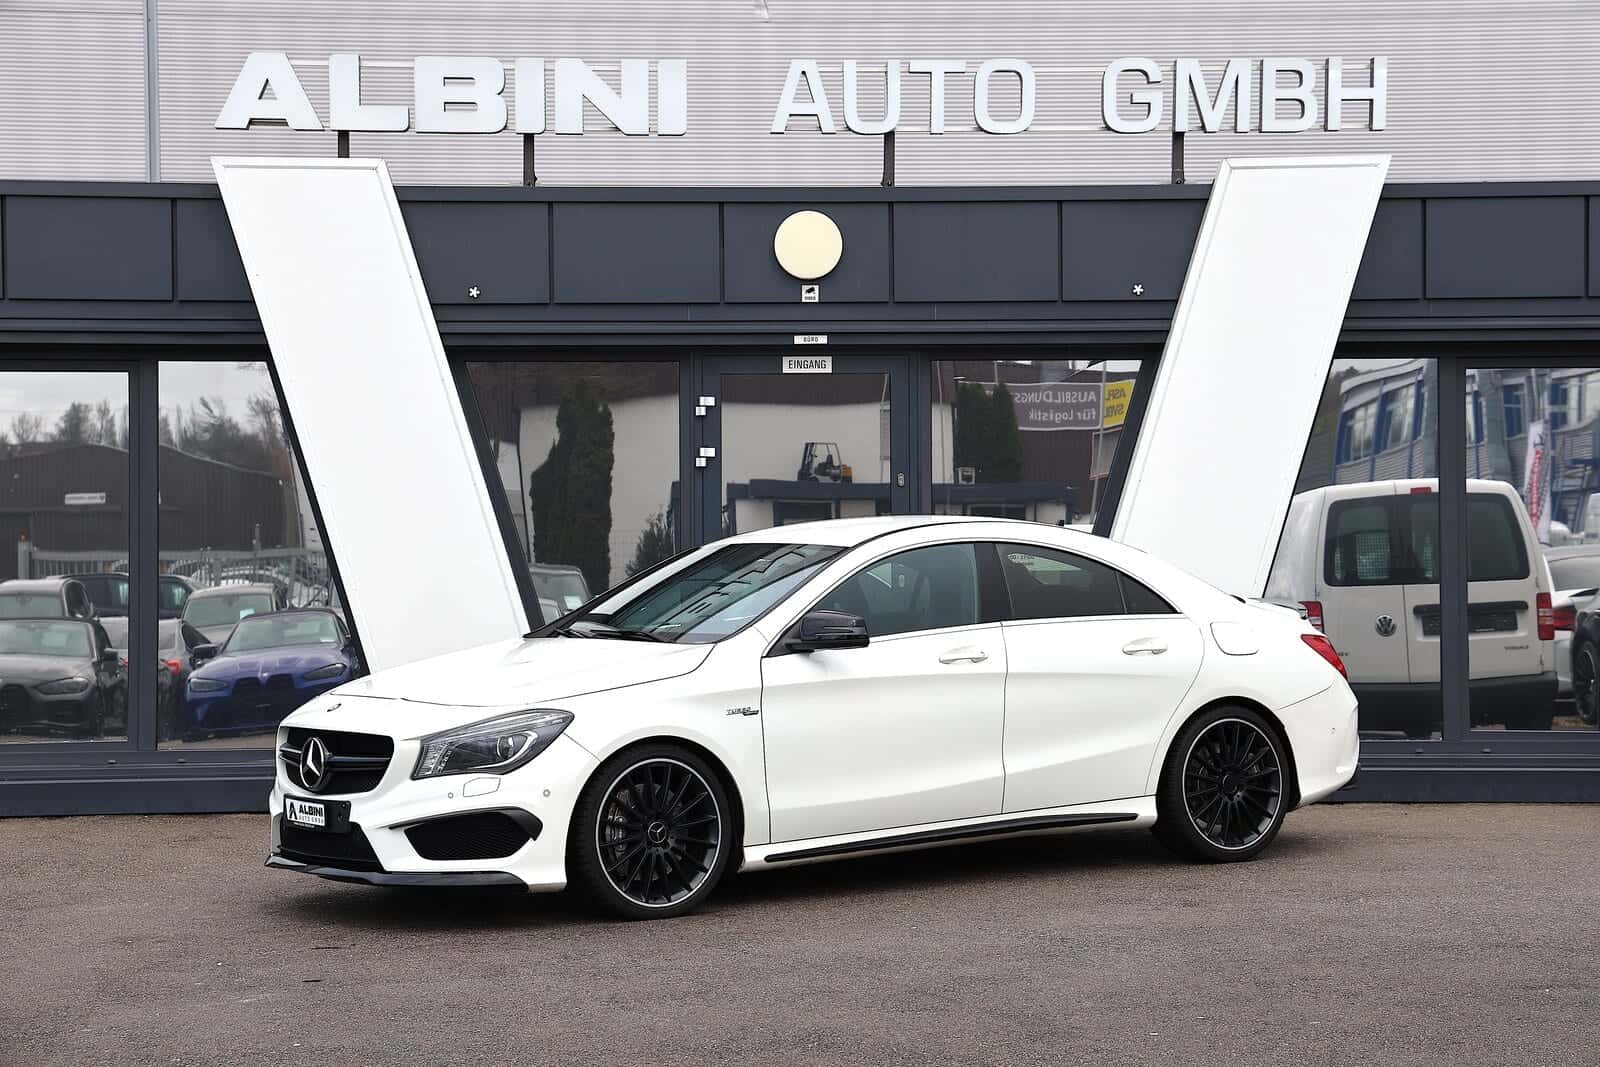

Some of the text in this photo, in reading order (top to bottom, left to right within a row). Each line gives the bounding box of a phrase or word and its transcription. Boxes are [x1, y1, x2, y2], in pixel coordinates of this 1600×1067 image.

[215, 52, 1389, 136] ALBINI AUTO GMBH
[788, 360, 827, 369] EINGANG
[299, 804, 323, 817] ALBINI
